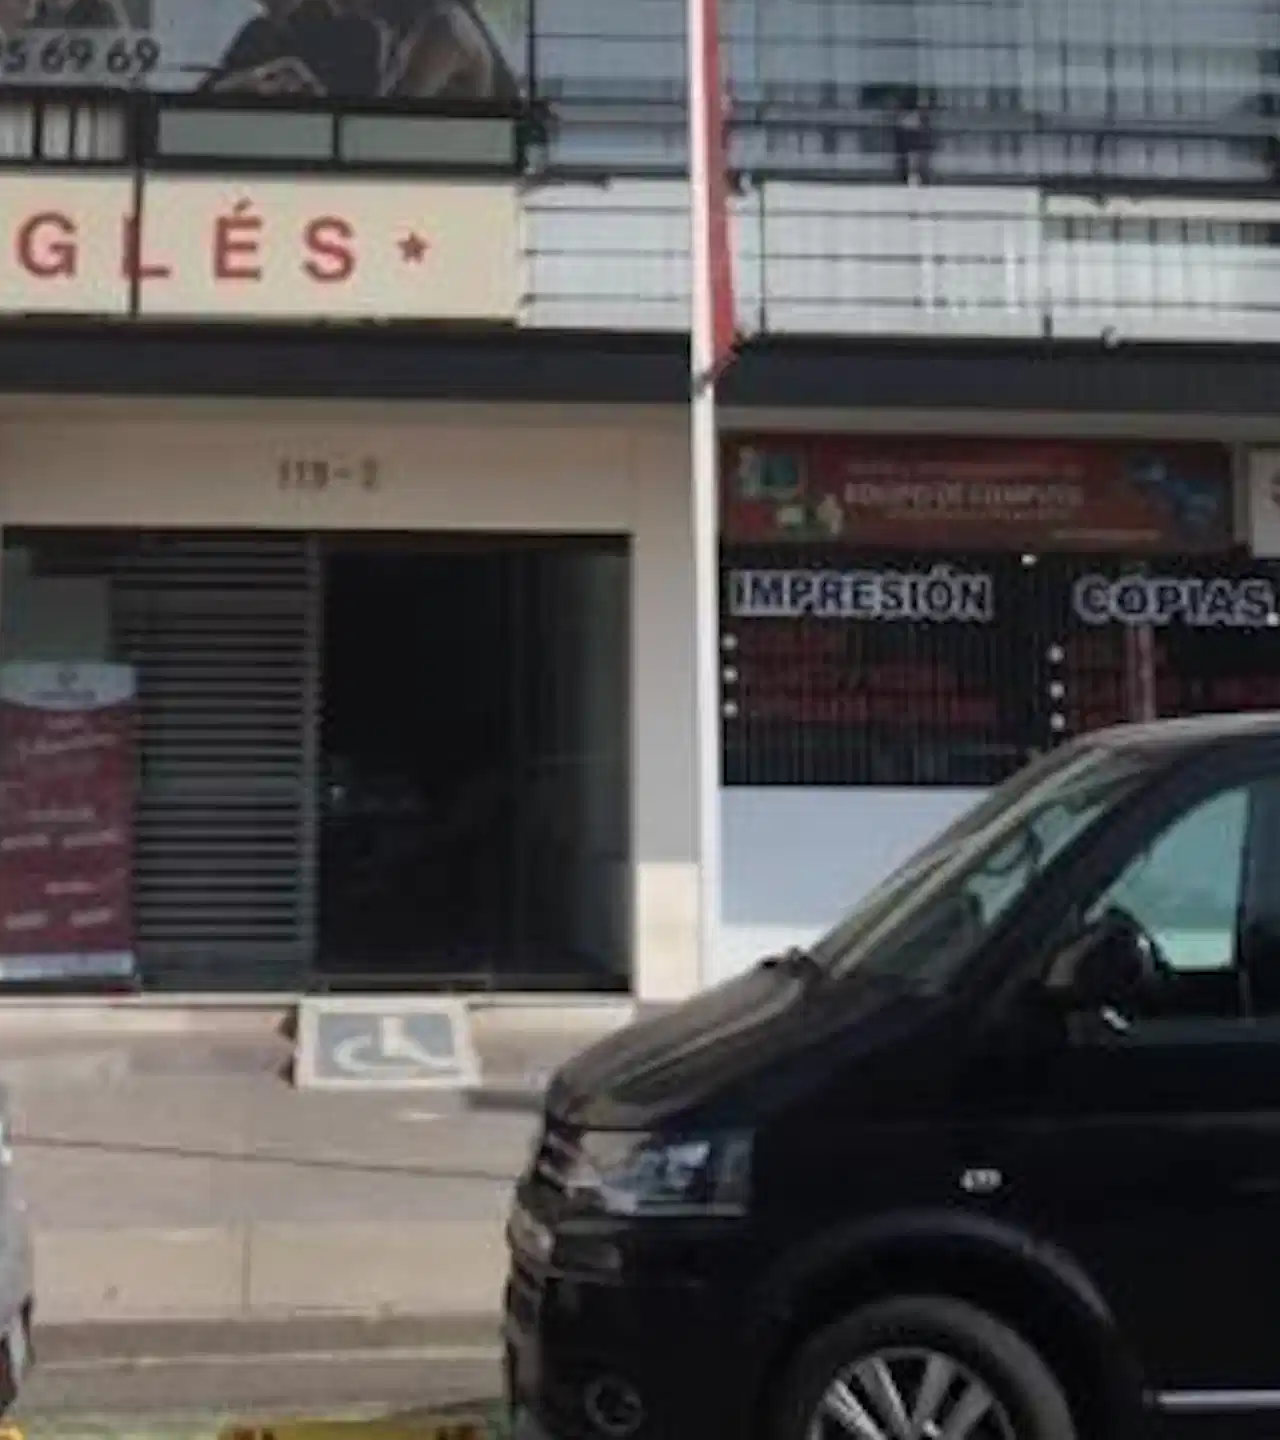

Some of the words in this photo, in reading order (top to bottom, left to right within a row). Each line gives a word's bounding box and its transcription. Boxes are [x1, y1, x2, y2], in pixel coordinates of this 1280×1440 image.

[40, 33, 97, 75] 69
[106, 35, 161, 75] 69
[731, 566, 995, 623] IMPRESIÓN
[1074, 574, 1280, 628] COPIAS
